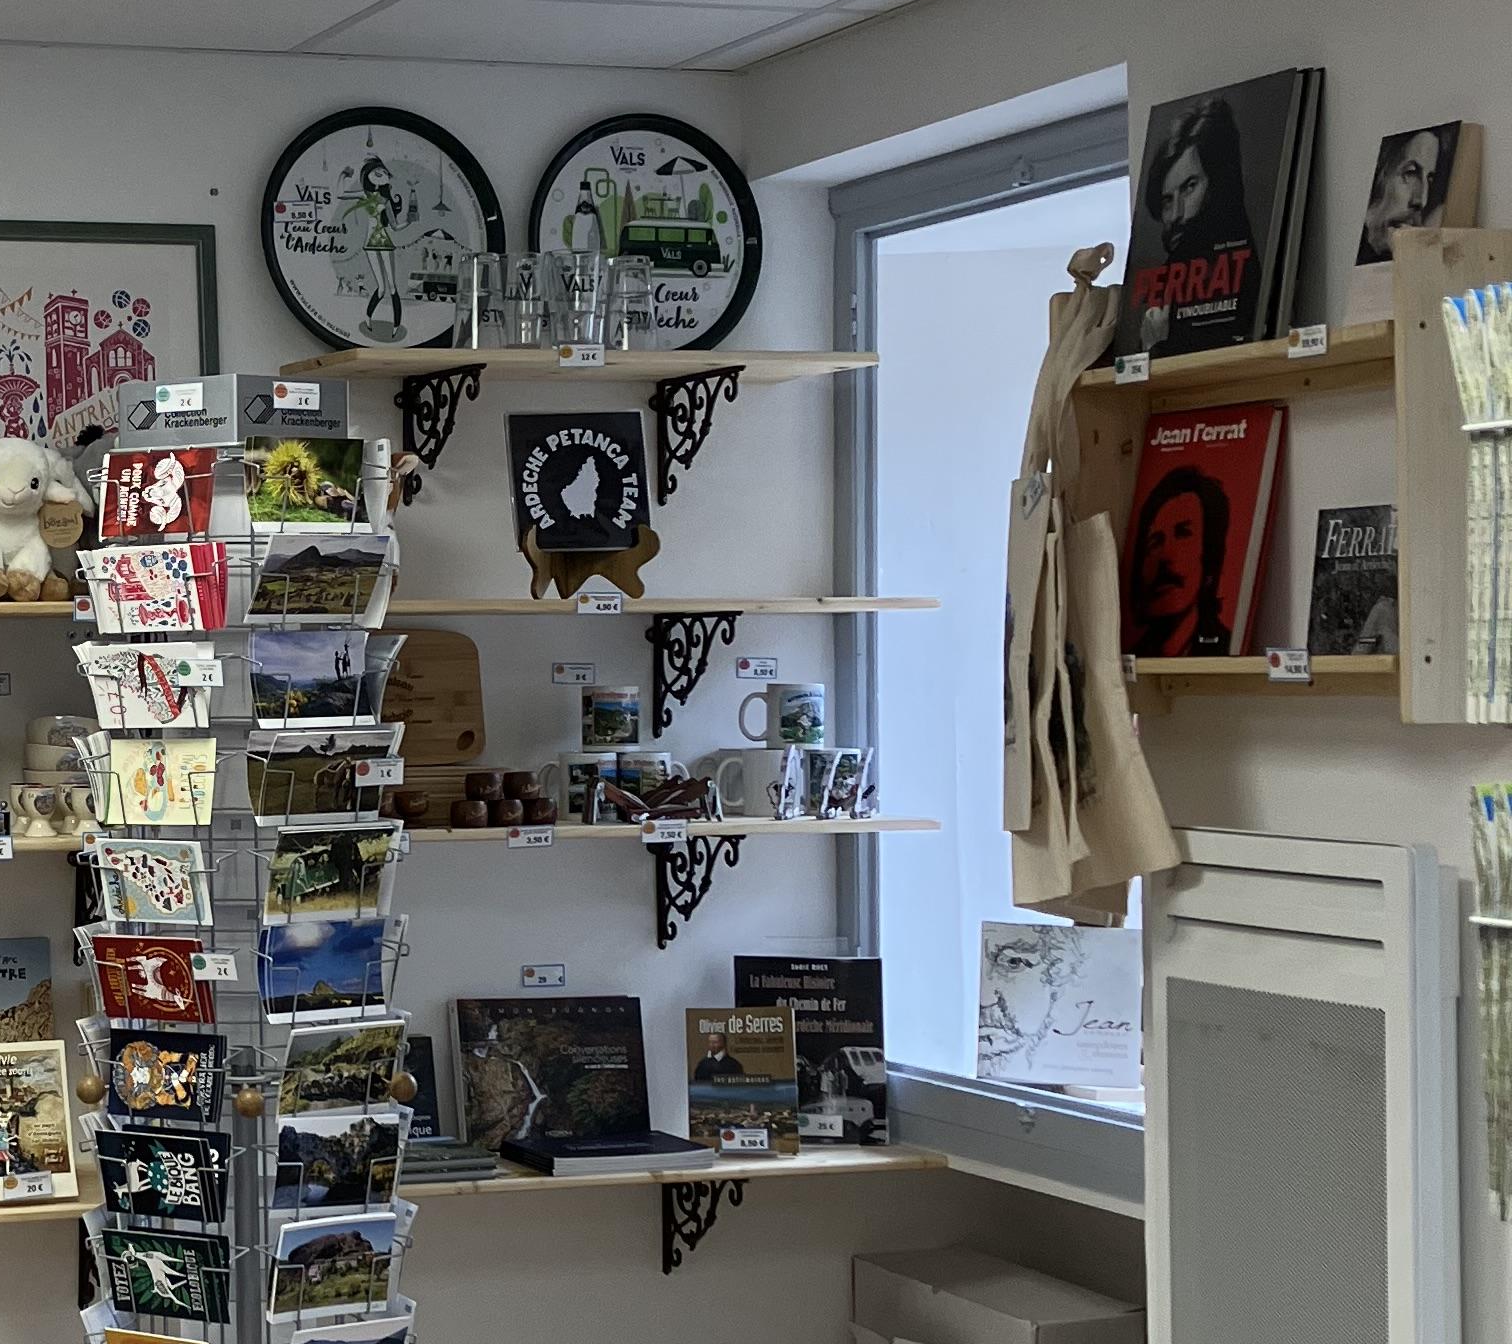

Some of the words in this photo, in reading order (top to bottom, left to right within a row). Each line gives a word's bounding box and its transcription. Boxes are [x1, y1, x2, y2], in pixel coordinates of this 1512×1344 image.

[610, 145, 647, 167] VALS
[1131, 247, 1254, 310] FERRAT
[591, 353, 598, 361] €
[180, 398, 186, 407] 2
[187, 398, 192, 407] €
[304, 397, 310, 406] €
[1151, 427, 1192, 446] Jean
[1192, 418, 1248, 443] Ferrat
[522, 445, 556, 531] ARDECHE
[545, 428, 630, 470] PETANCA
[611, 472, 639, 529] TEAM
[201, 673, 207, 682] 2
[208, 673, 213, 682] €
[385, 768, 392, 777] €
[676, 830, 682, 839] €
[216, 966, 223, 976] 2
[223, 966, 229, 976] €
[1053, 999, 1133, 1037] Jean
[728, 1014, 744, 1034] de
[745, 1013, 784, 1034] Serres
[27, 1184, 38, 1193] 20
[37, 1183, 44, 1192] €
